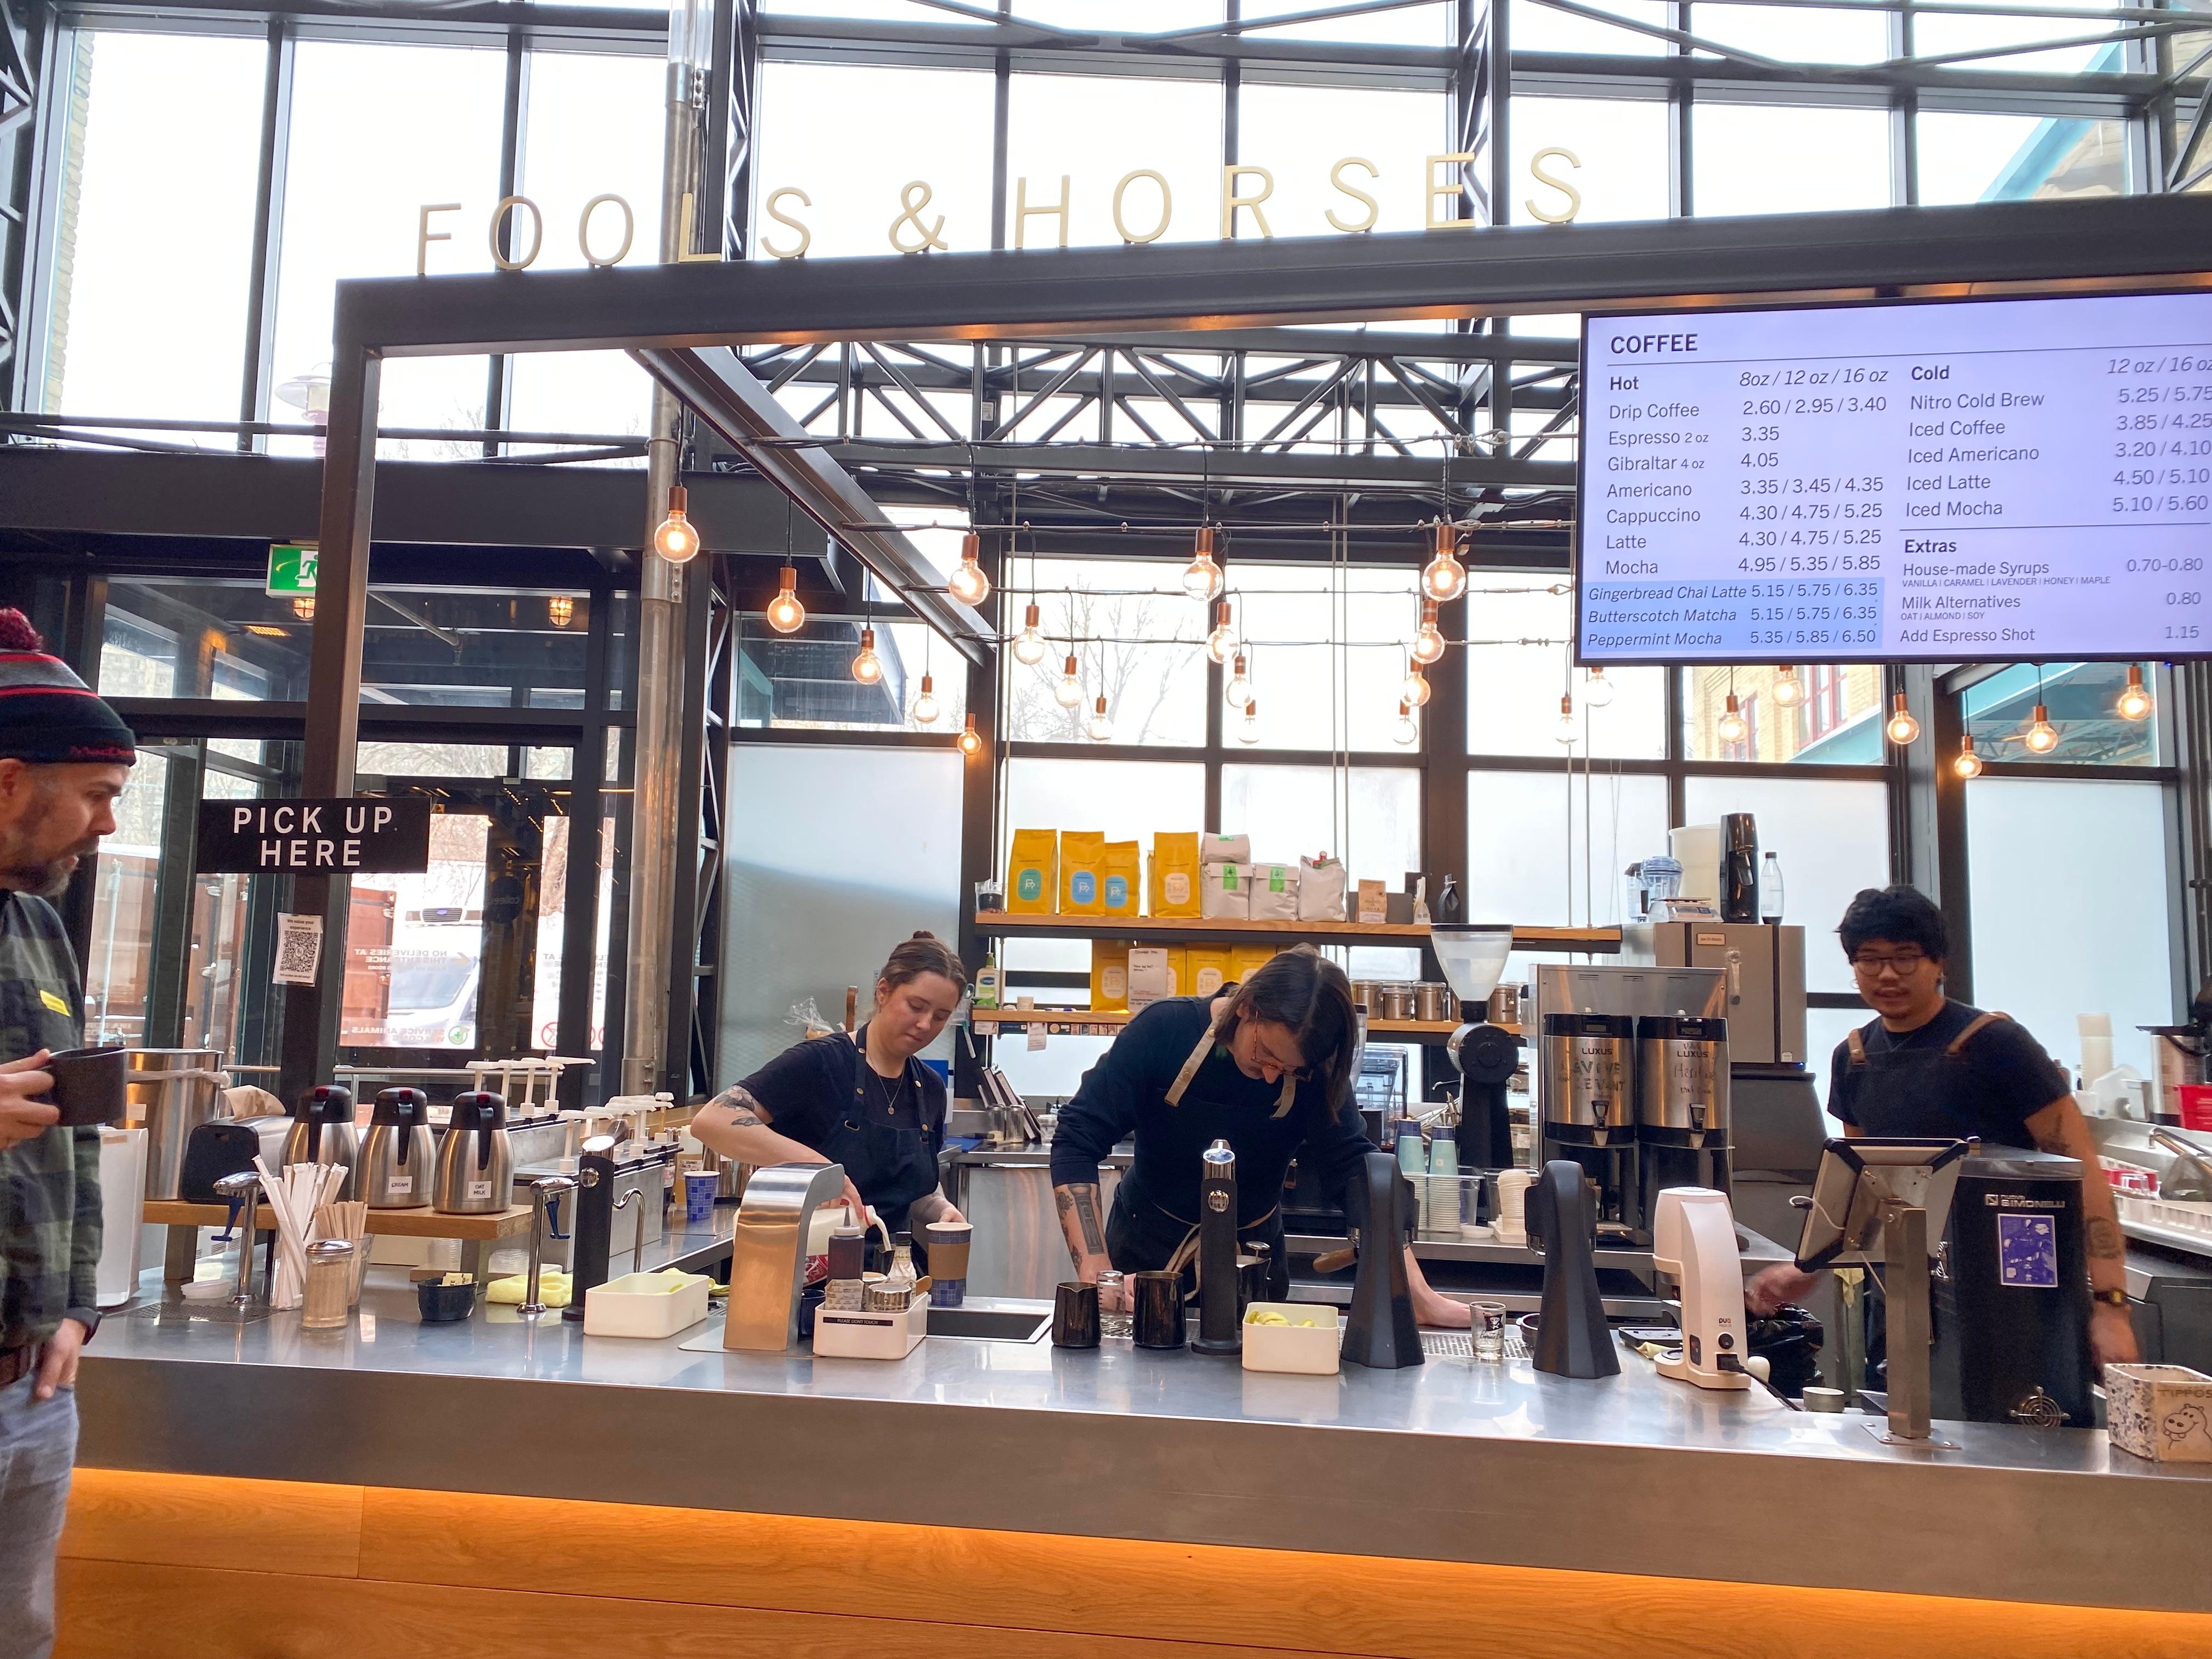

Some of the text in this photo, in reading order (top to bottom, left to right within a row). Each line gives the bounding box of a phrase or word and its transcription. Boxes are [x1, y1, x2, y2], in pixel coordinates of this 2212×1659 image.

[416, 146, 1582, 274] FOOLS & HORSES
[1611, 333, 1698, 354] COFFEE
[1911, 365, 1950, 381] Cold
[2107, 358, 2130, 374] 12
[2134, 361, 2155, 373] oz
[2169, 356, 2194, 372] 16
[1610, 376, 1639, 391] Hot
[1739, 371, 1770, 387] 8oz
[1784, 370, 1806, 385] 12
[1809, 373, 1829, 385] oz
[1843, 368, 1866, 383] 16
[1869, 370, 1889, 382] oz
[1911, 394, 1952, 410] Nitro
[1957, 393, 1995, 408] Cold
[2001, 392, 2045, 407] Brew
[2119, 387, 2159, 403] 5.25
[2174, 386, 2212, 402] 5.75
[1610, 404, 1642, 422] Drip
[1647, 403, 1700, 418] Coffee
[1743, 399, 1781, 415] 2.60
[1795, 398, 1833, 414] 2.95
[1848, 396, 1887, 412] 3.40
[1910, 421, 1944, 437] Iced
[1950, 419, 2005, 436] Coffee
[2117, 414, 2158, 431] 3.85
[2171, 413, 2212, 429] 4.25
[1609, 426, 1780, 448] Espresso 2 oz 3.35
[1608, 452, 1779, 471] Gibraltar 4 oz 4.05
[1909, 448, 1943, 464] Iced
[1948, 445, 2039, 462] Americano
[2115, 441, 2156, 458] 3.20
[2170, 439, 2212, 456] 4.10
[1606, 482, 1692, 498] Americano
[1741, 479, 1779, 495] 3.35
[1792, 478, 1831, 494] 3.45
[1844, 477, 1883, 492] 4.35
[1907, 475, 1942, 490] Iced
[1948, 475, 1991, 489] Latte
[2113, 469, 2154, 485] 4.50
[2169, 468, 2210, 484] 5.10
[1606, 507, 1701, 526] Cappuccino
[1740, 505, 1778, 521] 4.30
[1791, 504, 1830, 519] 4.75
[1844, 503, 1882, 518] 5.25
[1906, 501, 1941, 517] Iced
[1946, 500, 2002, 516] Mocha
[2113, 496, 2153, 512] 5.10
[2168, 495, 2208, 511] 5.60
[1606, 534, 1646, 549] Latte
[1739, 531, 1777, 546] 4.30
[1791, 530, 1829, 545] 4.75
[1843, 529, 1881, 544] 5.25
[1904, 539, 1957, 554] Extras
[1606, 560, 1658, 575] Mocha
[1738, 557, 1776, 572] 4.95
[1790, 556, 1828, 571] 5.35
[1842, 555, 1880, 571] 5.85
[1903, 557, 2203, 577] House-made Syrups 0.70-0.80
[1589, 586, 1674, 602] Gingerbread
[1677, 585, 1708, 599] Chai
[1711, 585, 1747, 598] Latte
[1751, 584, 1785, 597] 5.15
[1797, 583, 1831, 597] 5.75
[1843, 583, 1878, 596] 6.35
[1902, 576, 2111, 588] VANILLA CARAMEL LAVENDER HONEY MAPLE
[1902, 591, 2202, 610] Milk Alternatives 0.80
[1588, 609, 1679, 623] Butterscotch
[1683, 608, 1736, 622] Matcha
[1751, 607, 1784, 620] 5.15
[1797, 607, 1830, 620] 5.75
[1843, 606, 1877, 619] 6.35
[1900, 611, 1985, 620] OAT ALMOND SOY
[1588, 633, 1671, 648] Peppermint
[1674, 631, 1722, 645] Mocha
[1750, 631, 1783, 644] 5.35
[1796, 630, 1829, 643] 5.85
[1842, 629, 1876, 643] 6.50
[1900, 625, 2199, 644] Add Espresso Shot 1.15
[233, 806, 392, 834] PICK UP
[261, 839, 361, 866] HERE
